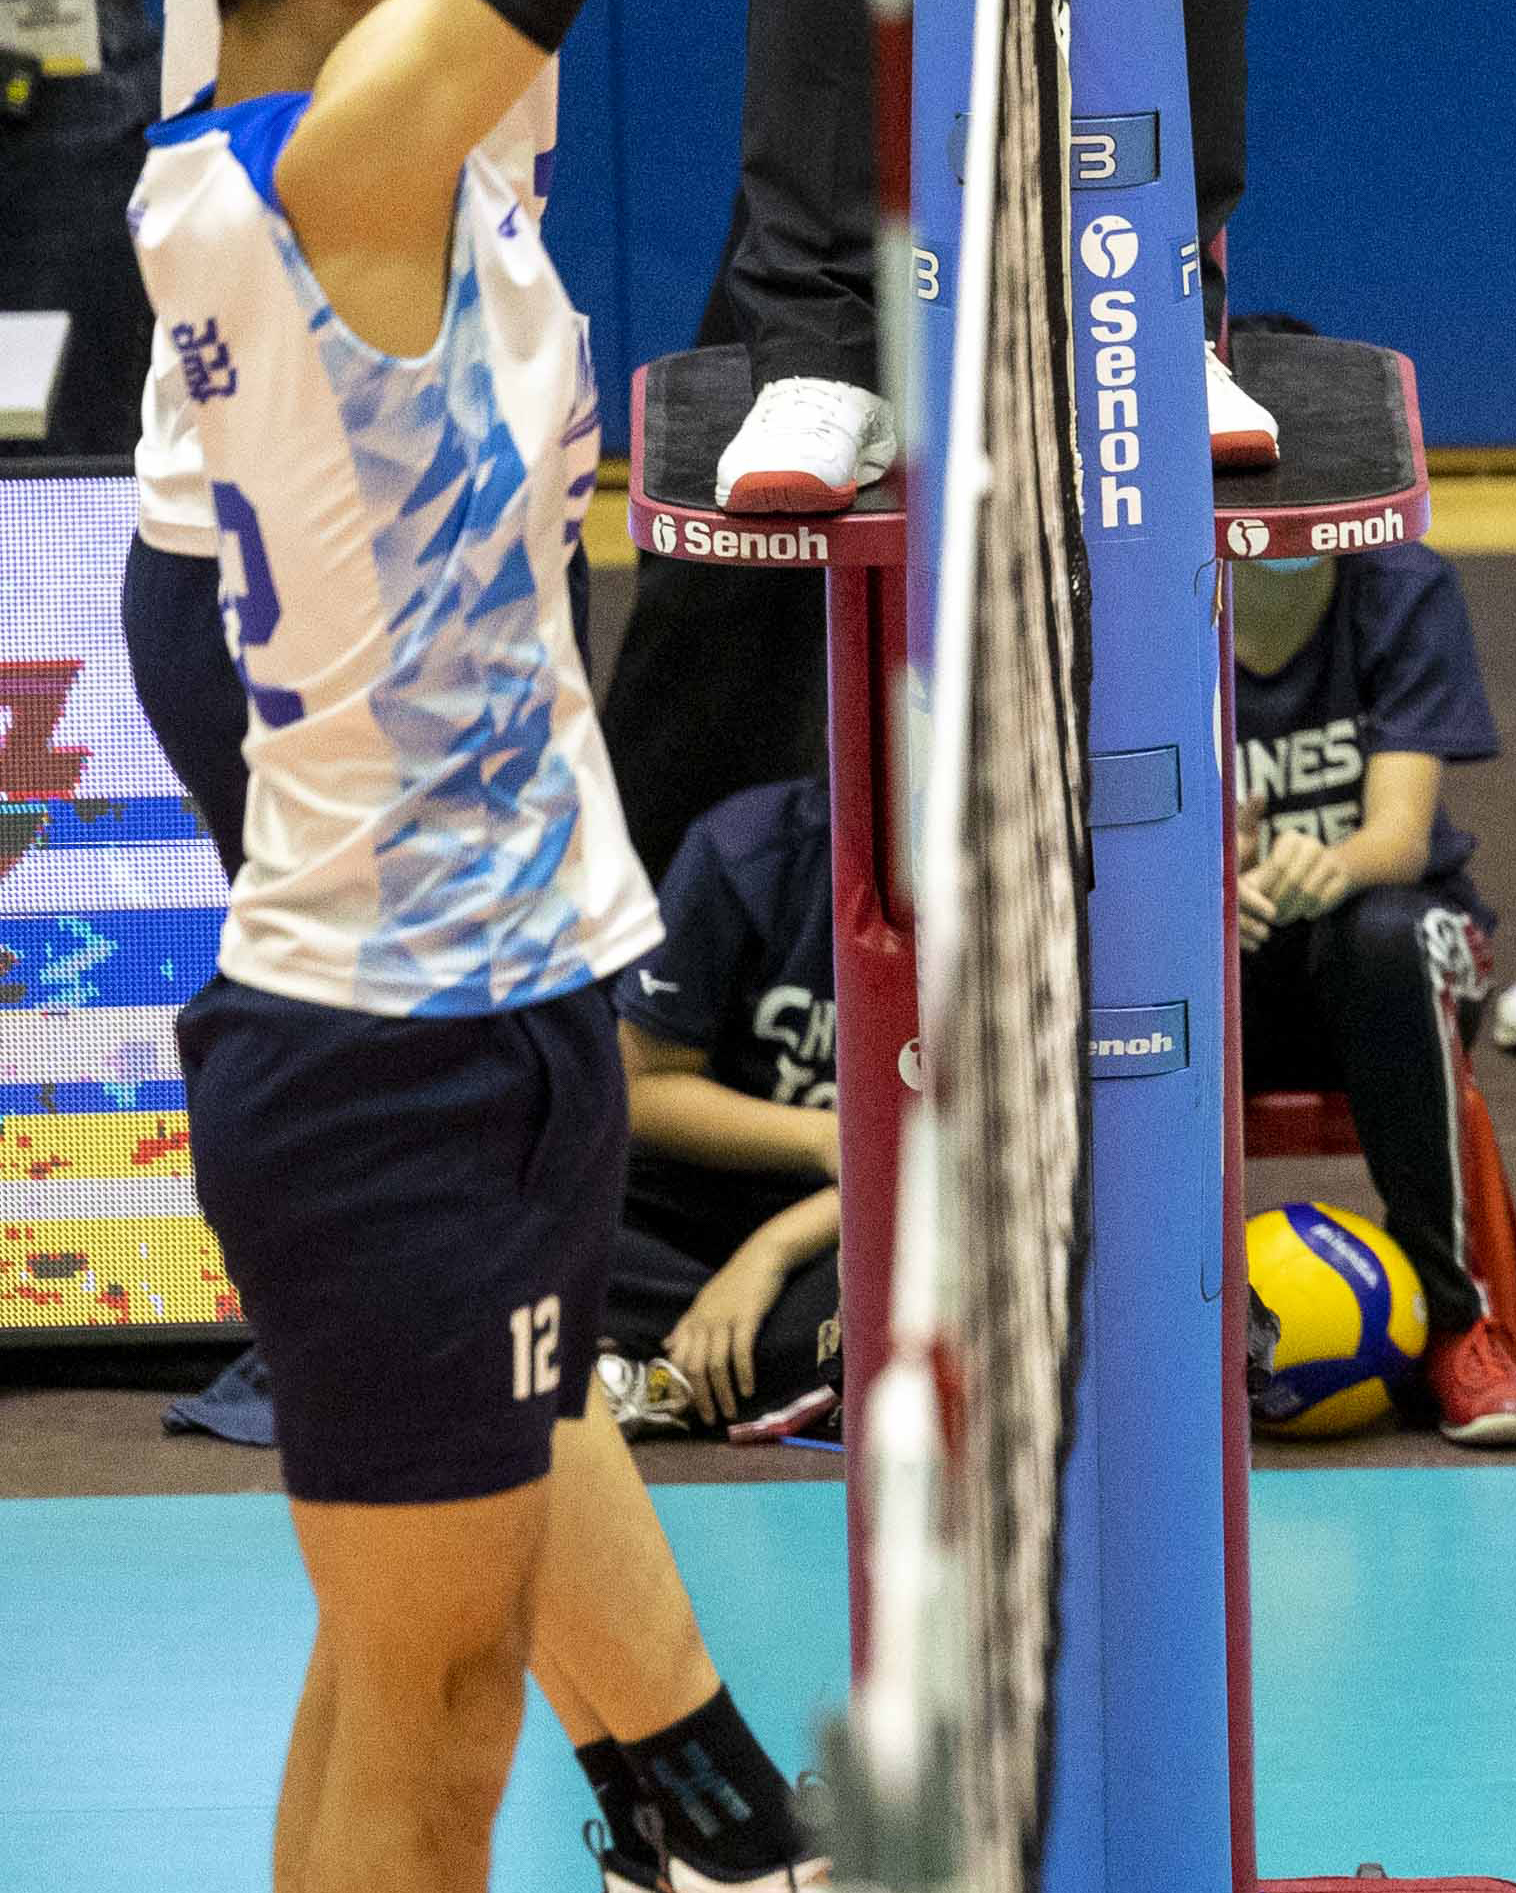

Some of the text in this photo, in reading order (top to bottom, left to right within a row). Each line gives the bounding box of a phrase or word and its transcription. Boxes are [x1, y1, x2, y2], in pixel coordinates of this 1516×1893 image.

[1090, 290, 1143, 528] Senoh
[684, 521, 828, 560] Senoh
[510, 1293, 561, 1401] 12
